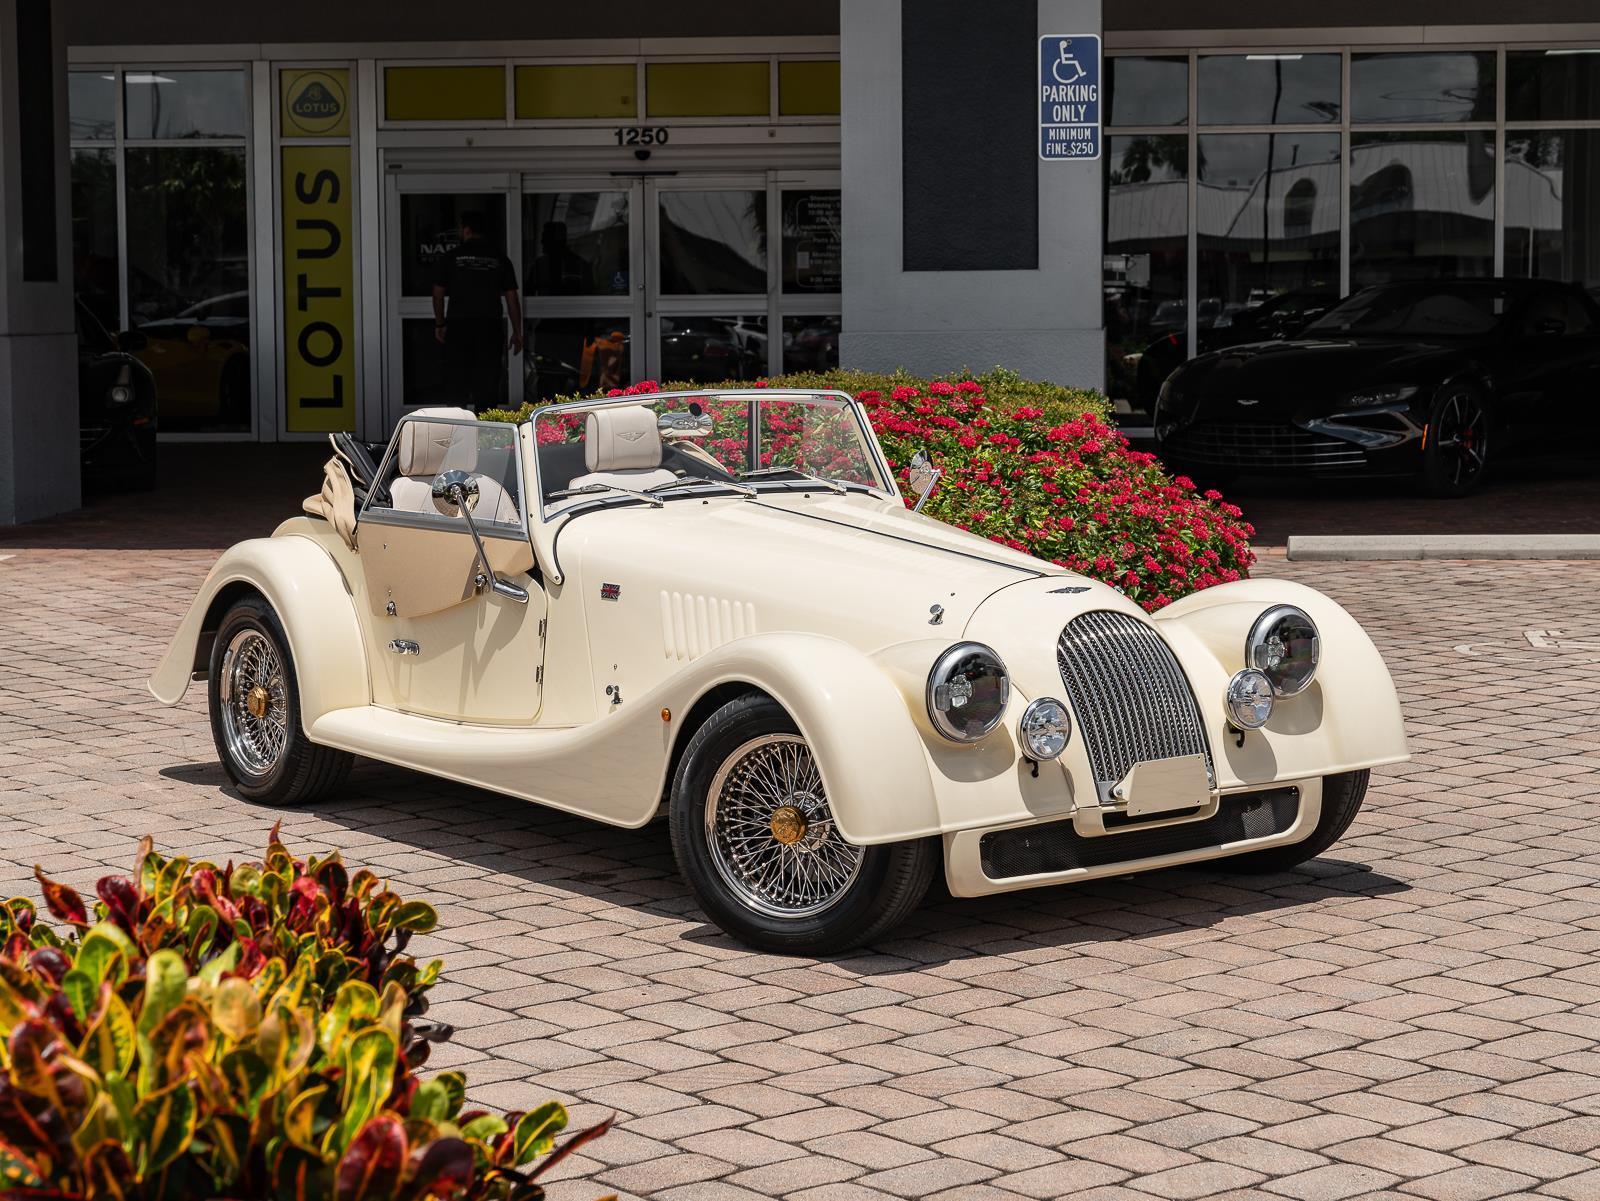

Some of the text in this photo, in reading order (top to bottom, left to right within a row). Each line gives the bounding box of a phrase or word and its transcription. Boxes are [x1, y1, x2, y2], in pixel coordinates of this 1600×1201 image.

[1042, 84, 1097, 102] PARKING
[296, 103, 337, 113] LOTUS
[1053, 104, 1087, 122] ONLY
[614, 127, 669, 146] 1250
[1049, 127, 1091, 140] MINIMUM
[1046, 141, 1094, 156] FINE $250
[295, 168, 343, 409] LOTUS
